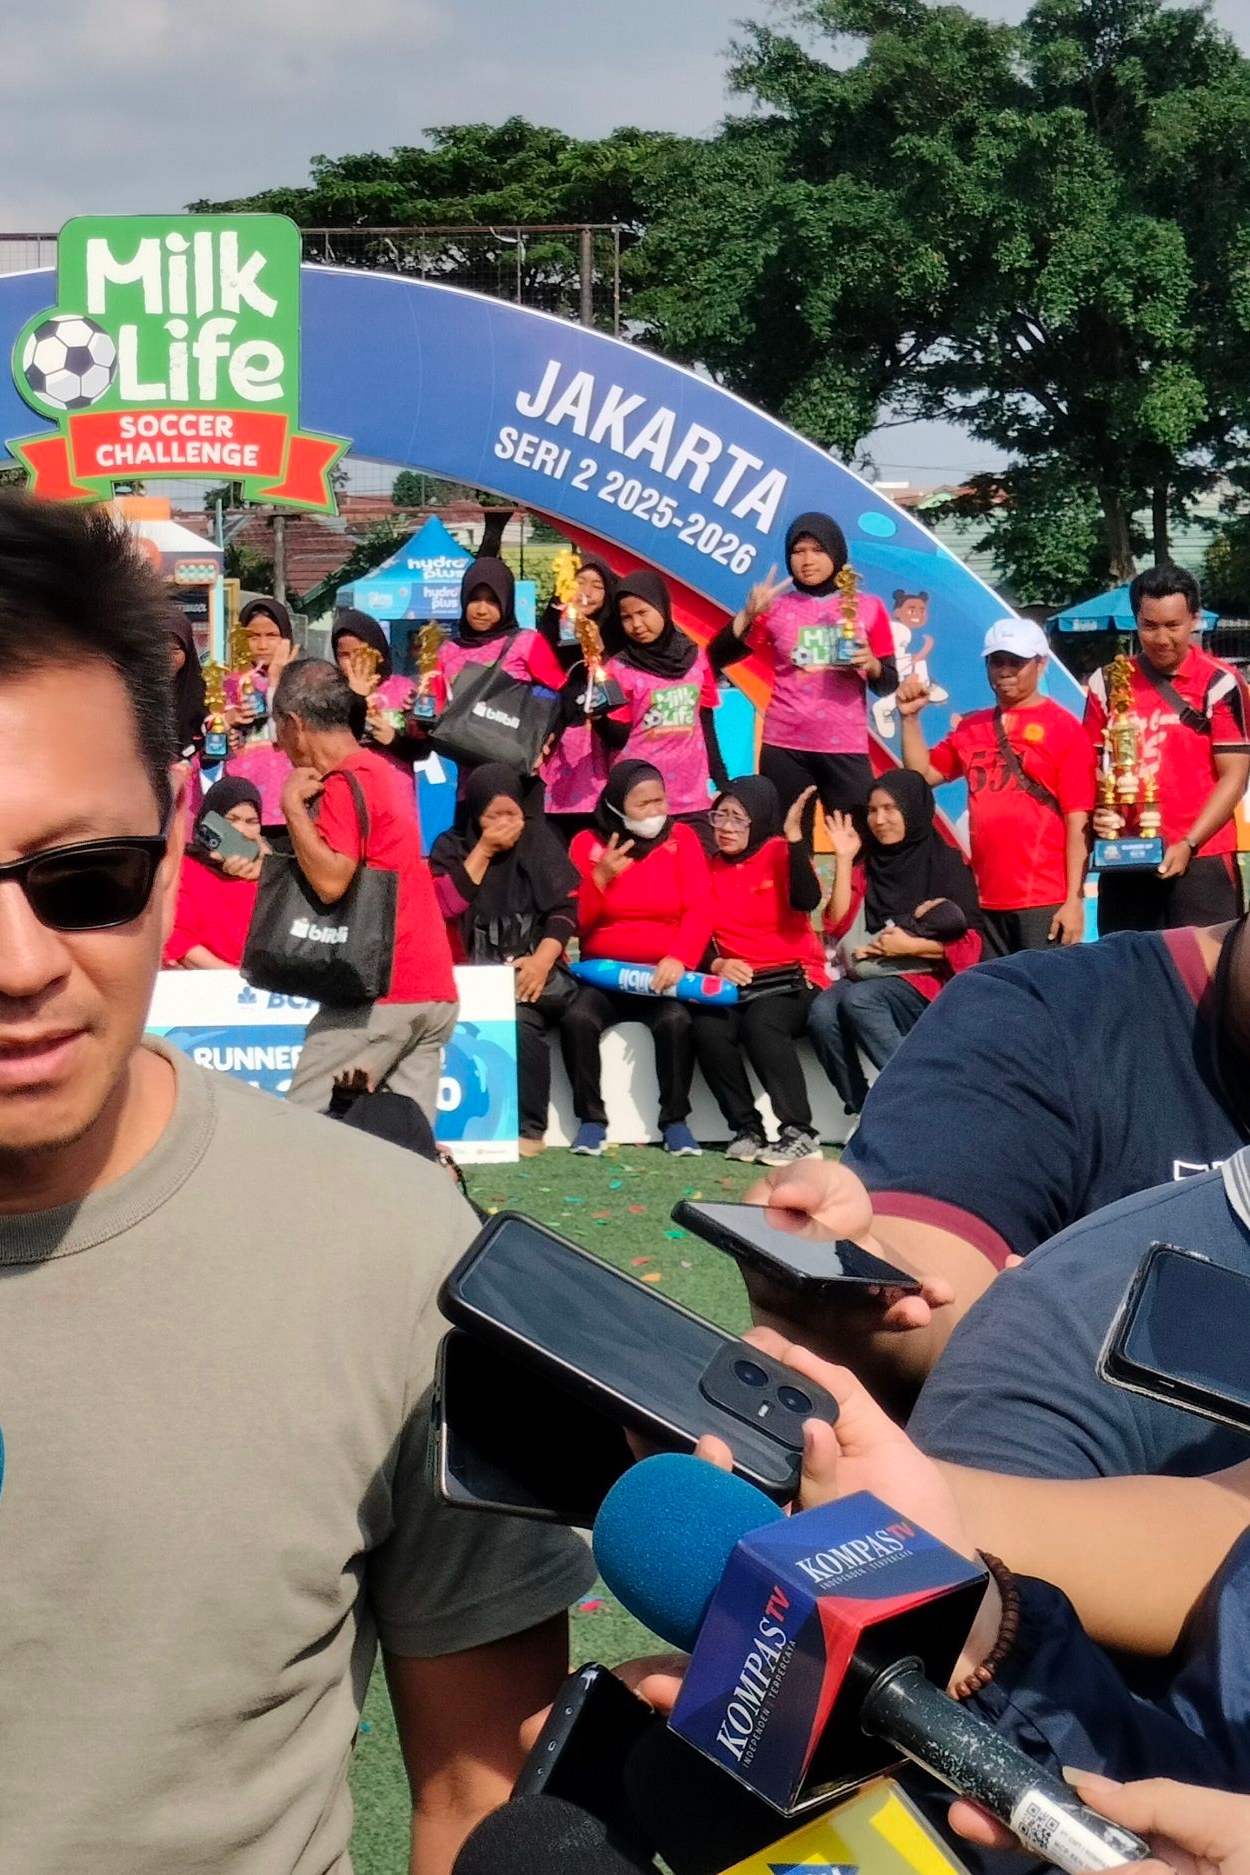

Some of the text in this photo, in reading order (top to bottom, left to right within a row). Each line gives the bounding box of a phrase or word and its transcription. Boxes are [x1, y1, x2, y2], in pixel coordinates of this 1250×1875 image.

[86, 231, 278, 318] Milk
[118, 317, 284, 402] Life
[119, 414, 233, 438] SOCCER
[515, 359, 788, 535] JAKARTA
[95, 442, 259, 467] CHALLENGE
[494, 426, 757, 575] SERI 2 2025-2026
[407, 556, 467, 571] hydro
[423, 586, 459, 600] hydro
[431, 598, 458, 610] plus
[743, 1640, 796, 1769] INDEPENDEN TERPERCAYA
